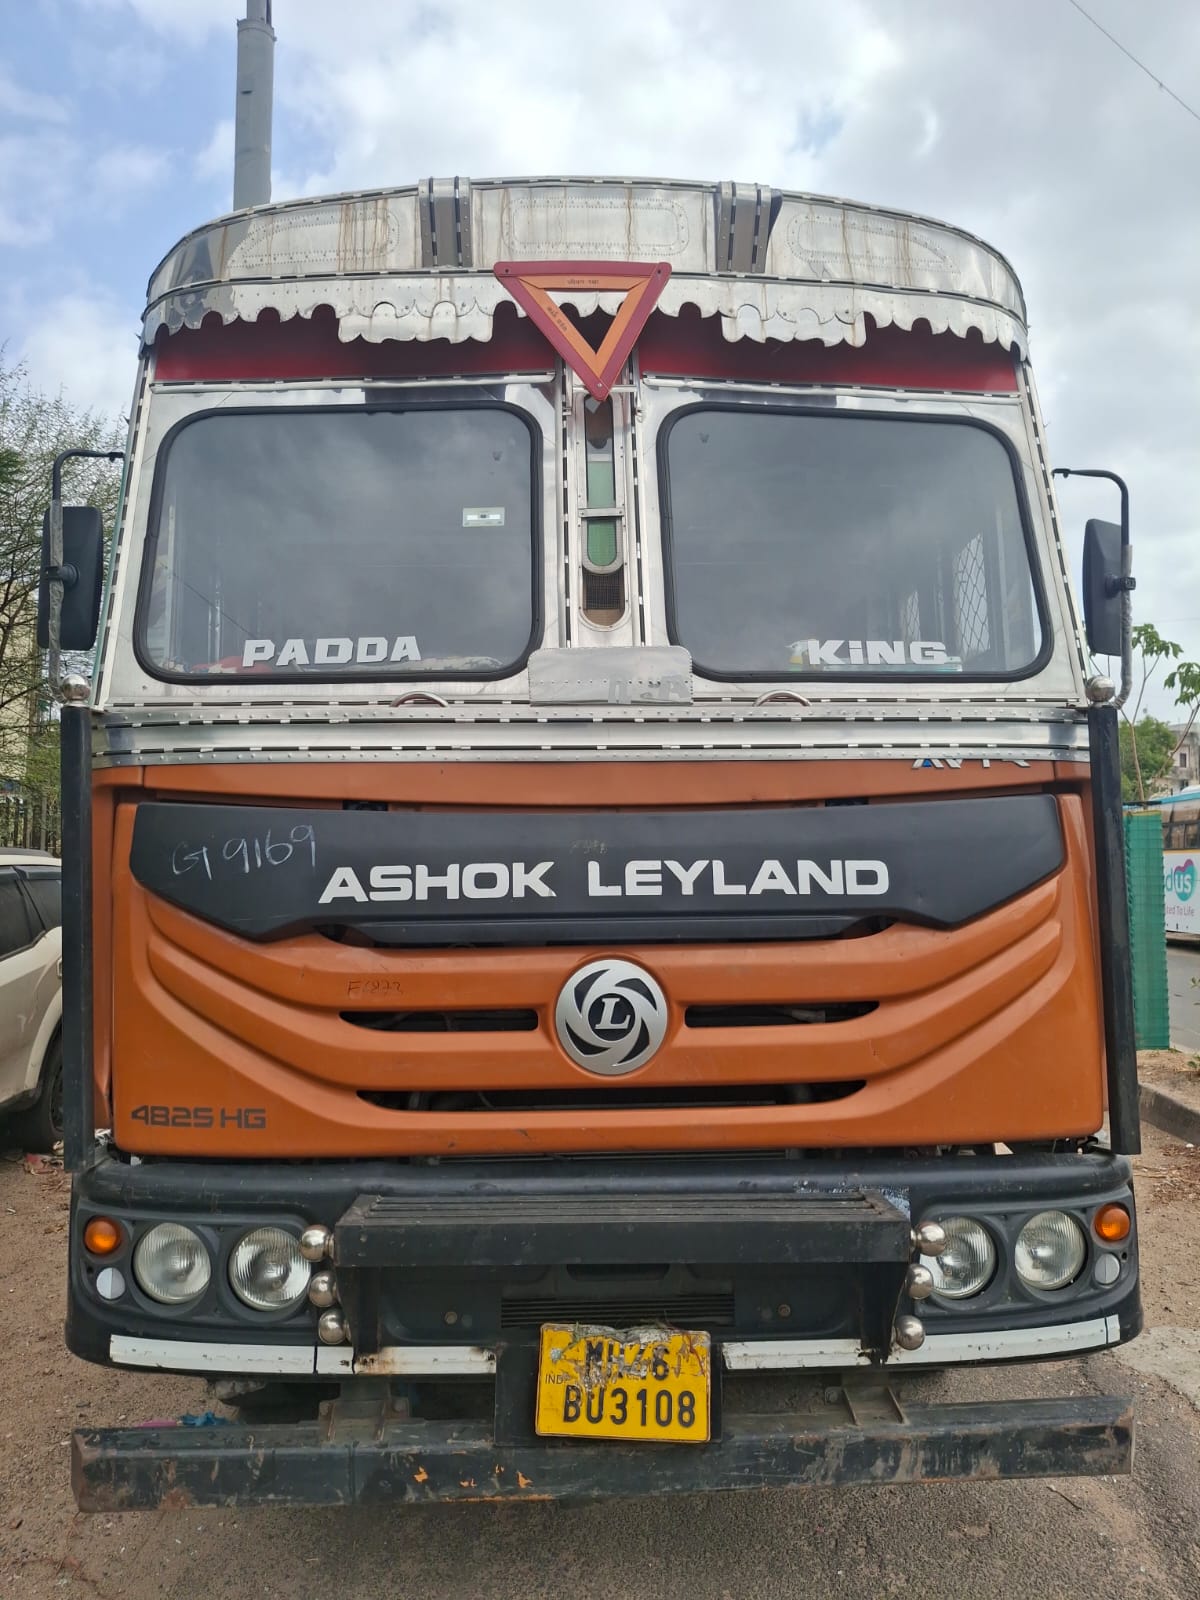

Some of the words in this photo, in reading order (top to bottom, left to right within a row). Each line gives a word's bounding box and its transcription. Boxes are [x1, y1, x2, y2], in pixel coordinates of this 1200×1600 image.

[242, 635, 422, 667] PADDA
[318, 861, 557, 904] ASHOK
[587, 859, 890, 897] LEYLAND
[131, 1105, 214, 1128] 4825
[220, 1107, 266, 1129] HG
[545, 1373, 564, 1385] IND
[563, 1384, 696, 1428] BU3108
